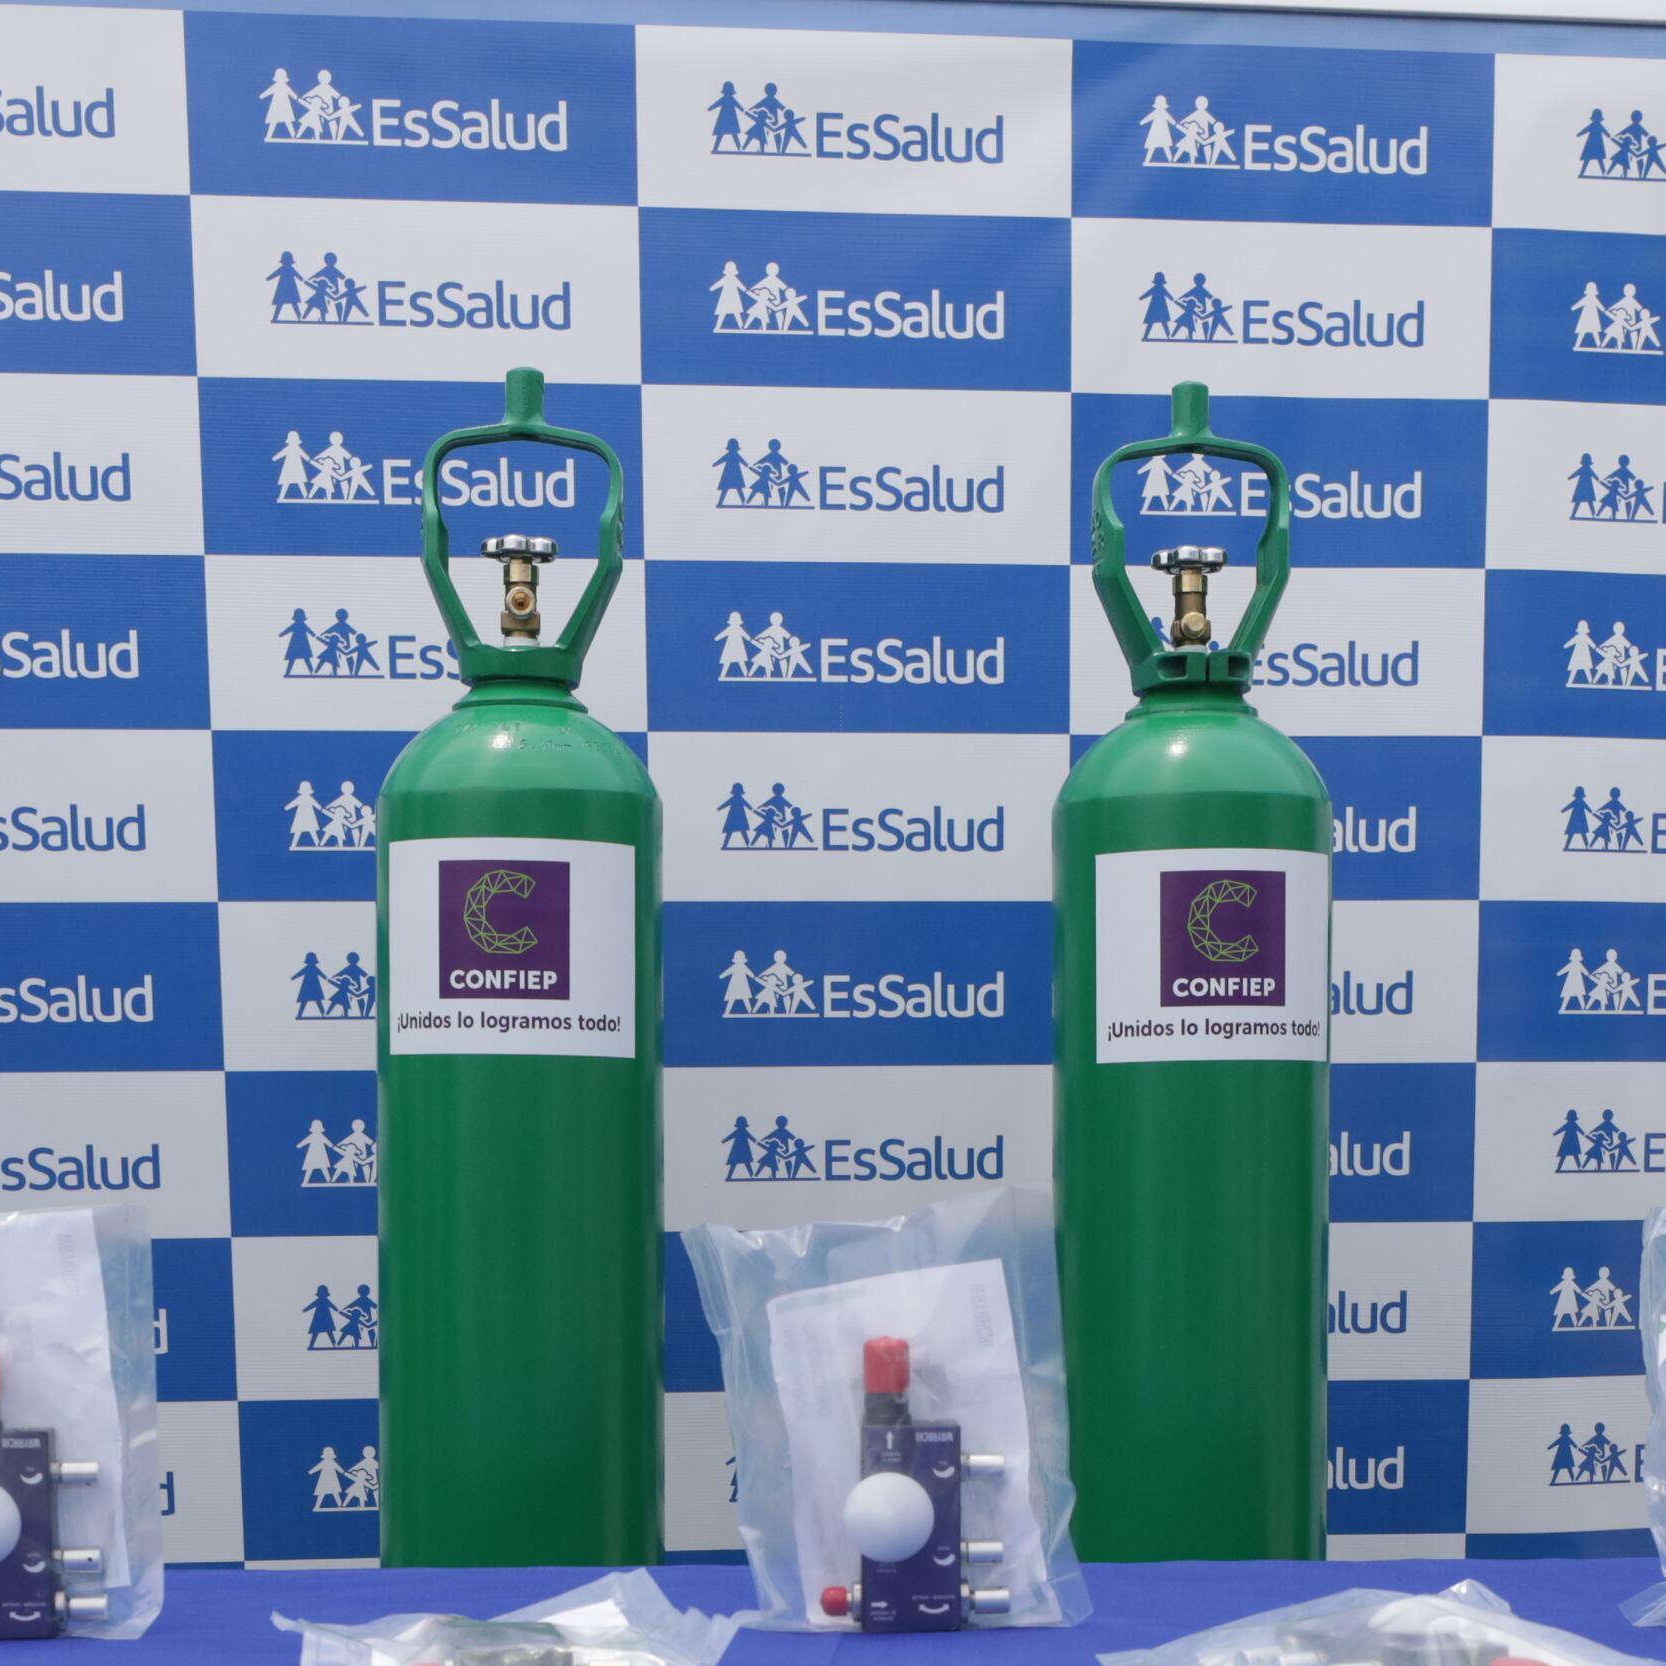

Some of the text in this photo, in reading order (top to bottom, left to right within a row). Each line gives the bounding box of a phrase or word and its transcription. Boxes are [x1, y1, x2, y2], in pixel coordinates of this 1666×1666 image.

[372, 99, 567, 151] EsSalud
[816, 112, 1003, 163] EsSalud
[1245, 124, 1428, 175] EsSalud
[378, 280, 571, 330] EsSalud
[818, 289, 1004, 339] EsSalud
[1243, 300, 1424, 347] EsSalud
[819, 465, 1004, 513] EsSalud
[1241, 471, 1422, 519] ESalud
[821, 636, 1004, 684] EsSalud
[823, 806, 1004, 852] EsSalud
[449, 969, 558, 990] CONFIEP
[824, 972, 1004, 1018] EsSalud
[1172, 977, 1276, 997] CONFIEP
[397, 1011, 621, 1033] ¡Unidos lo logramos todo!
[1108, 1018, 1320, 1041] ¡Unidos lo logramos todo!
[825, 1135, 1003, 1181] EsSalud
